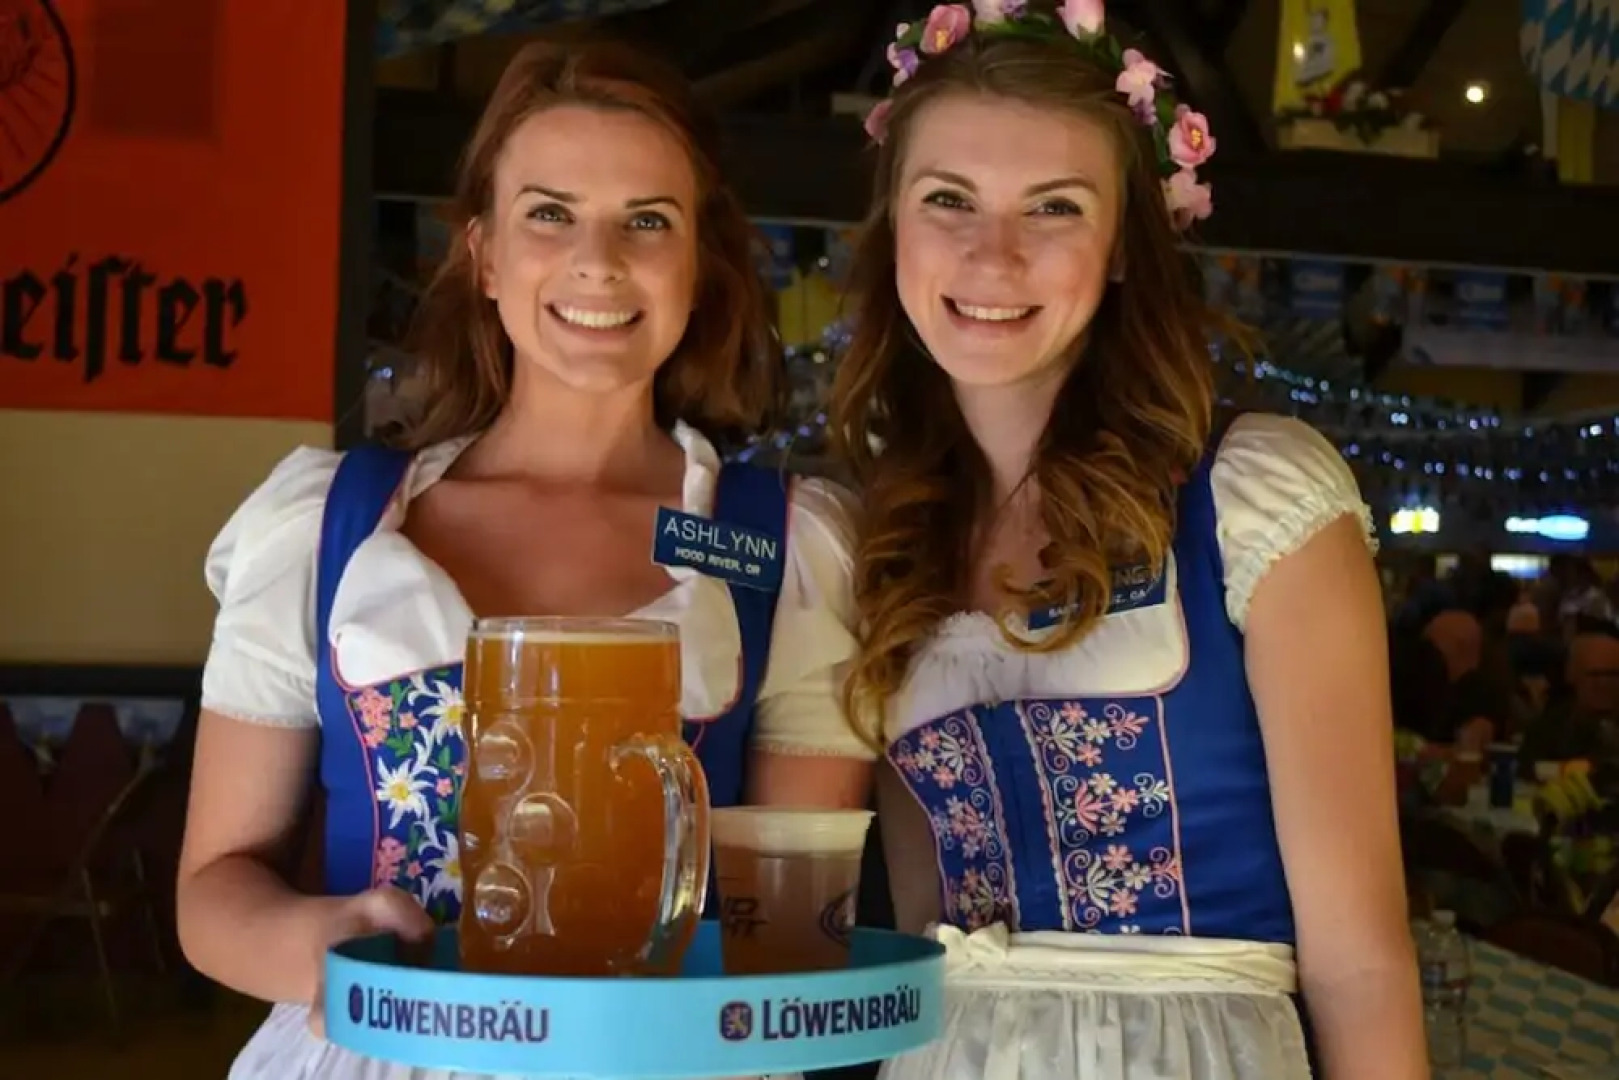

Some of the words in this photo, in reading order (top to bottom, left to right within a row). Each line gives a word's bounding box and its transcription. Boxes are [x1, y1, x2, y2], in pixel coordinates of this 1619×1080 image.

[663, 516, 777, 560] ASHLYNN
[367, 986, 549, 1043] LÖWENBRÄU
[762, 983, 922, 1041] LÖWENBRÄU
